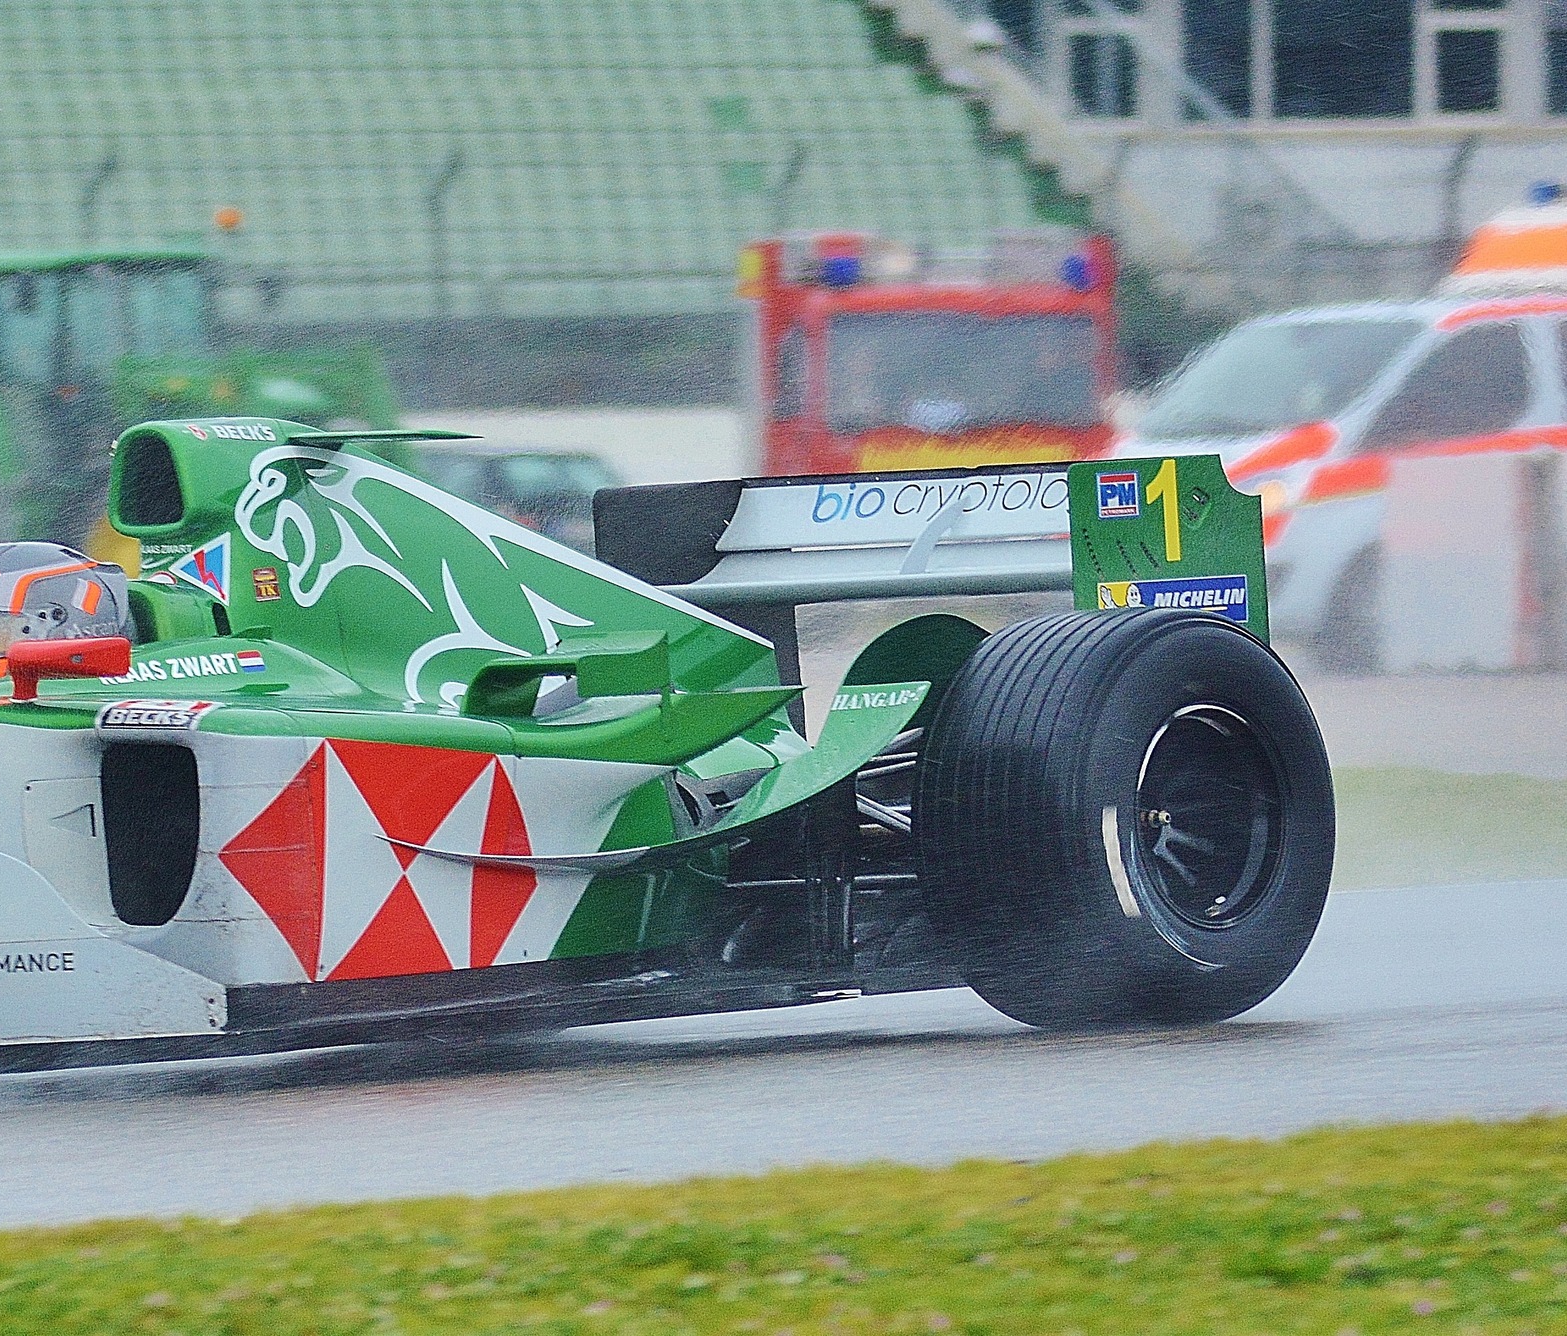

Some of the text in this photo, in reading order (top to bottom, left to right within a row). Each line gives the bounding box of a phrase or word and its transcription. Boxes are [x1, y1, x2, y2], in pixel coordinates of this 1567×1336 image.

[210, 422, 277, 442] BECK'S
[812, 473, 1071, 523] bio cryptolo
[1100, 482, 1137, 507] PM
[1145, 458, 1182, 562] 1
[1153, 587, 1245, 608] MICHELIN
[165, 652, 238, 679] ZWART
